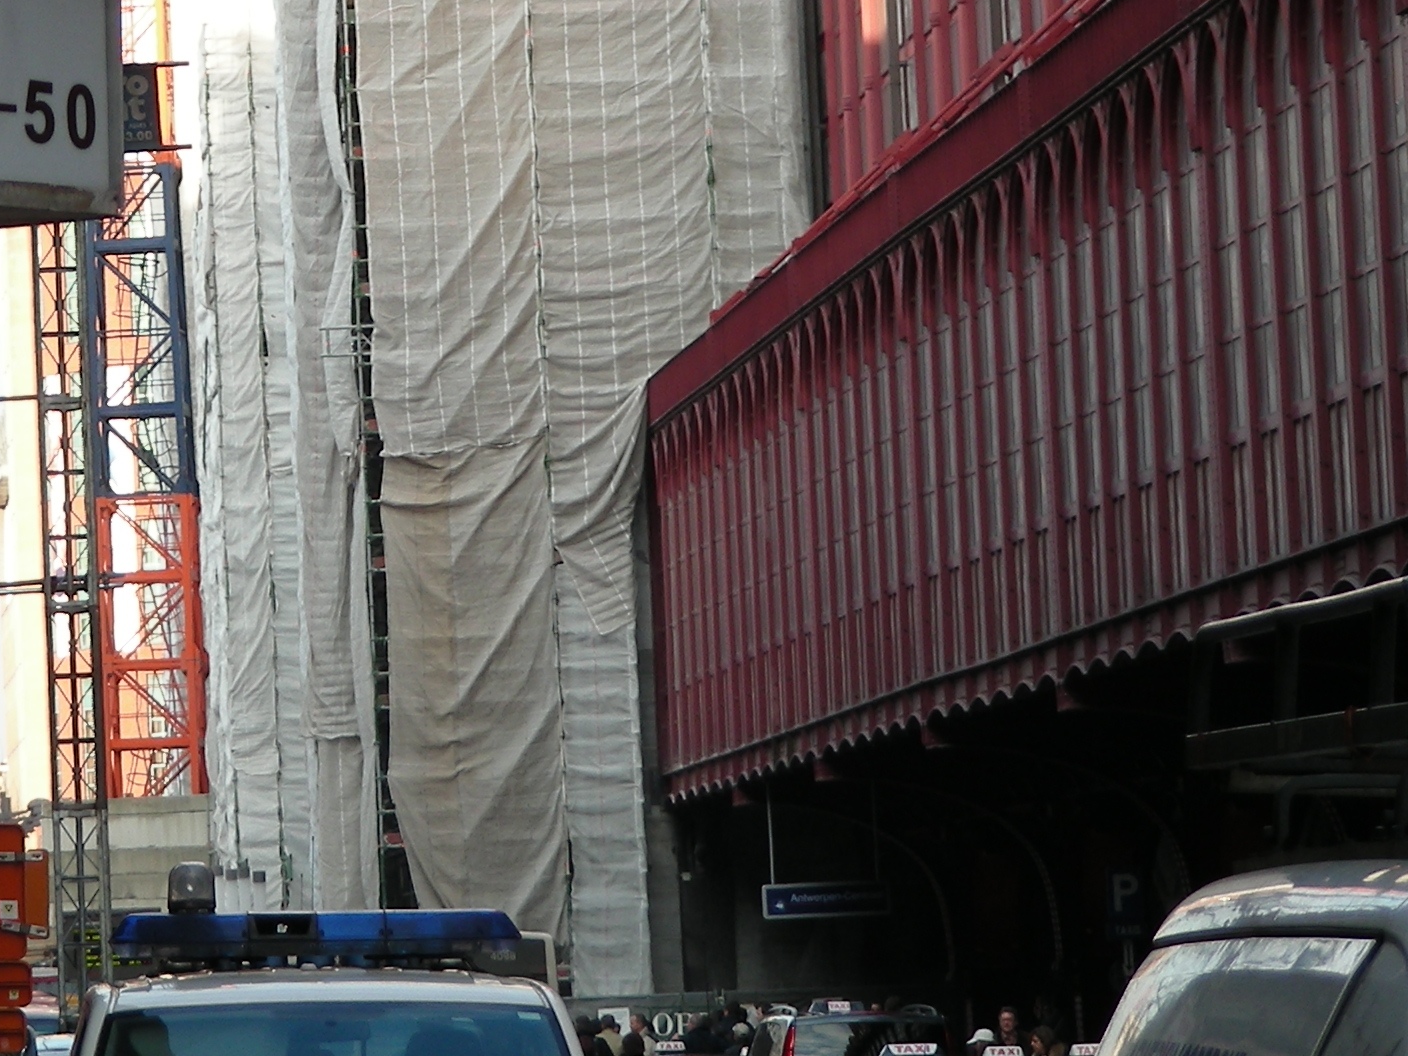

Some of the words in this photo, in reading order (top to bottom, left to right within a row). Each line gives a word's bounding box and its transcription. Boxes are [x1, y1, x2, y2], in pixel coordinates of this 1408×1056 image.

[23, 79, 98, 150] 50
[1112, 873, 1139, 913] P
[829, 1002, 850, 1011] TAXI
[894, 1044, 931, 1054] TAXI
[989, 1047, 1021, 1056] TAXI
